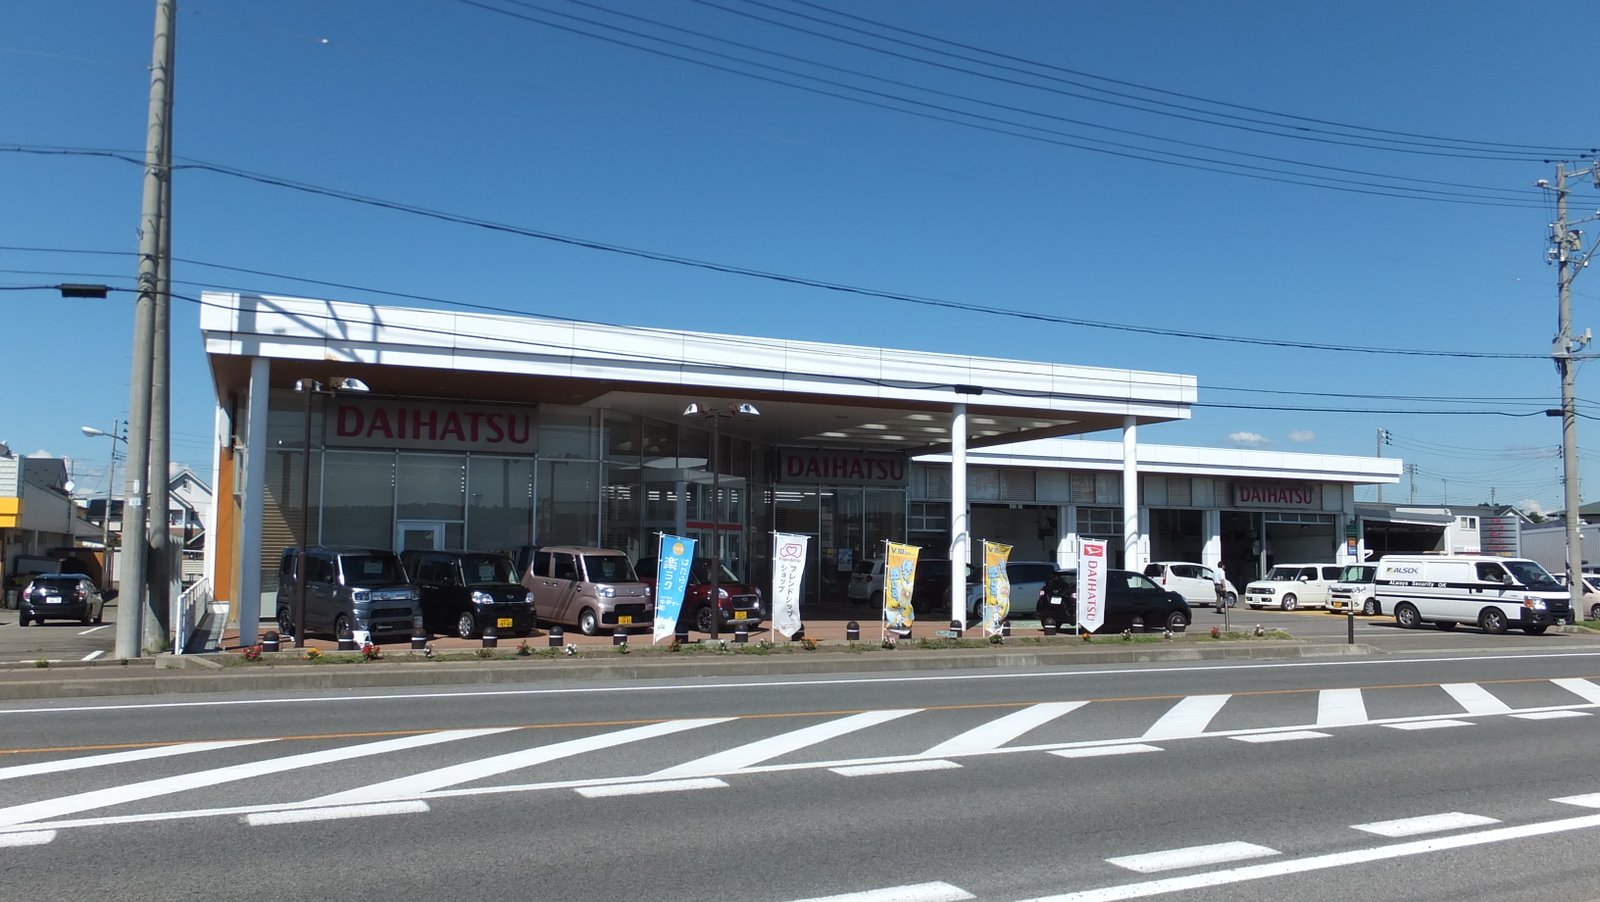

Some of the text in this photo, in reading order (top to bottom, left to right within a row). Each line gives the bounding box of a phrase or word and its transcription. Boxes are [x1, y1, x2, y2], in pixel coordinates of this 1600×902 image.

[337, 405, 530, 444] DAIHATSU
[787, 455, 904, 480] DAIHATSU
[1240, 486, 1312, 504] DAIHATSU
[778, 564, 788, 593] ショップ
[785, 565, 797, 618] フレンドシップ
[1087, 560, 1098, 622] DAIHATSU
